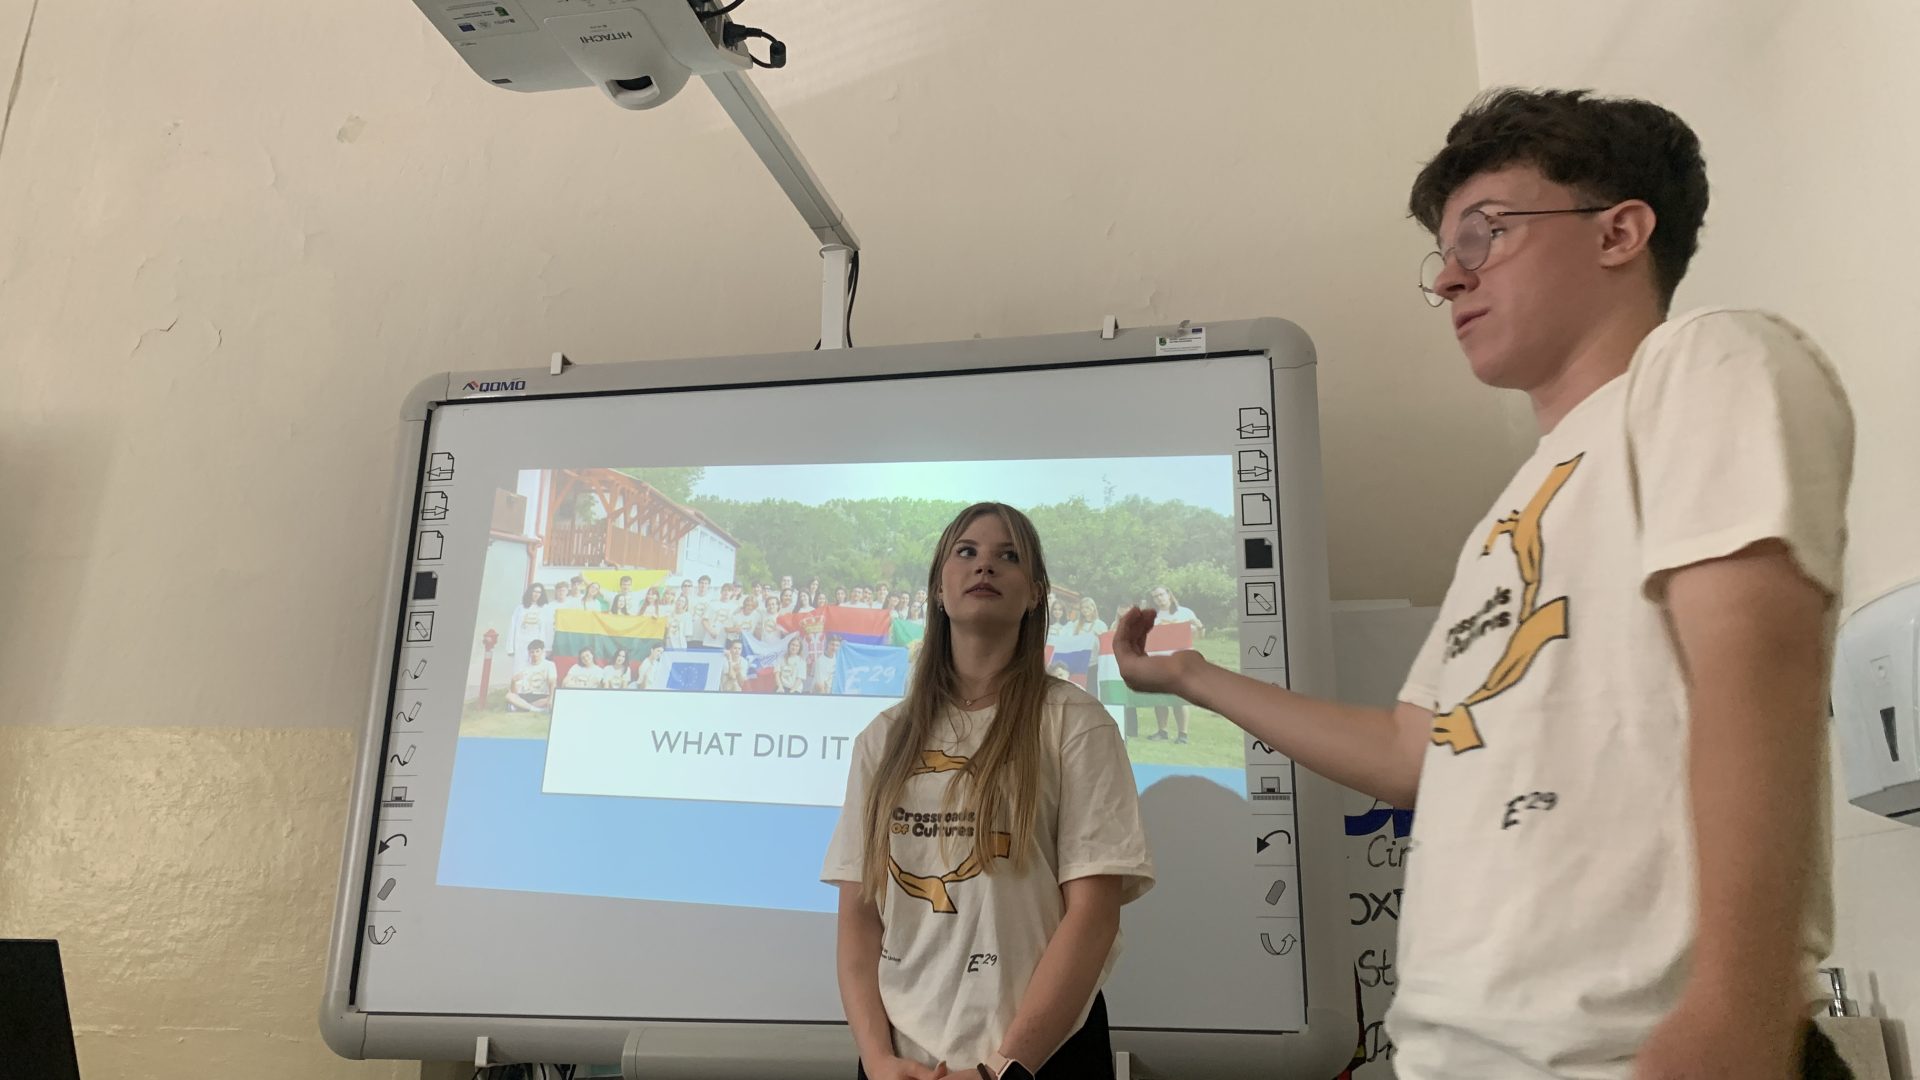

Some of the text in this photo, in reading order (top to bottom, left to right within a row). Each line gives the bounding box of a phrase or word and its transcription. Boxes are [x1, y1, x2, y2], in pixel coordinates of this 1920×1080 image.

[579, 31, 633, 44] HITACHI
[479, 380, 527, 392] QOMO
[651, 730, 849, 760] WHAT DID IT
[891, 807, 976, 824] Crossroads
[1500, 791, 1559, 830] E29
[967, 953, 998, 974] E29
[1358, 948, 1397, 990] St
